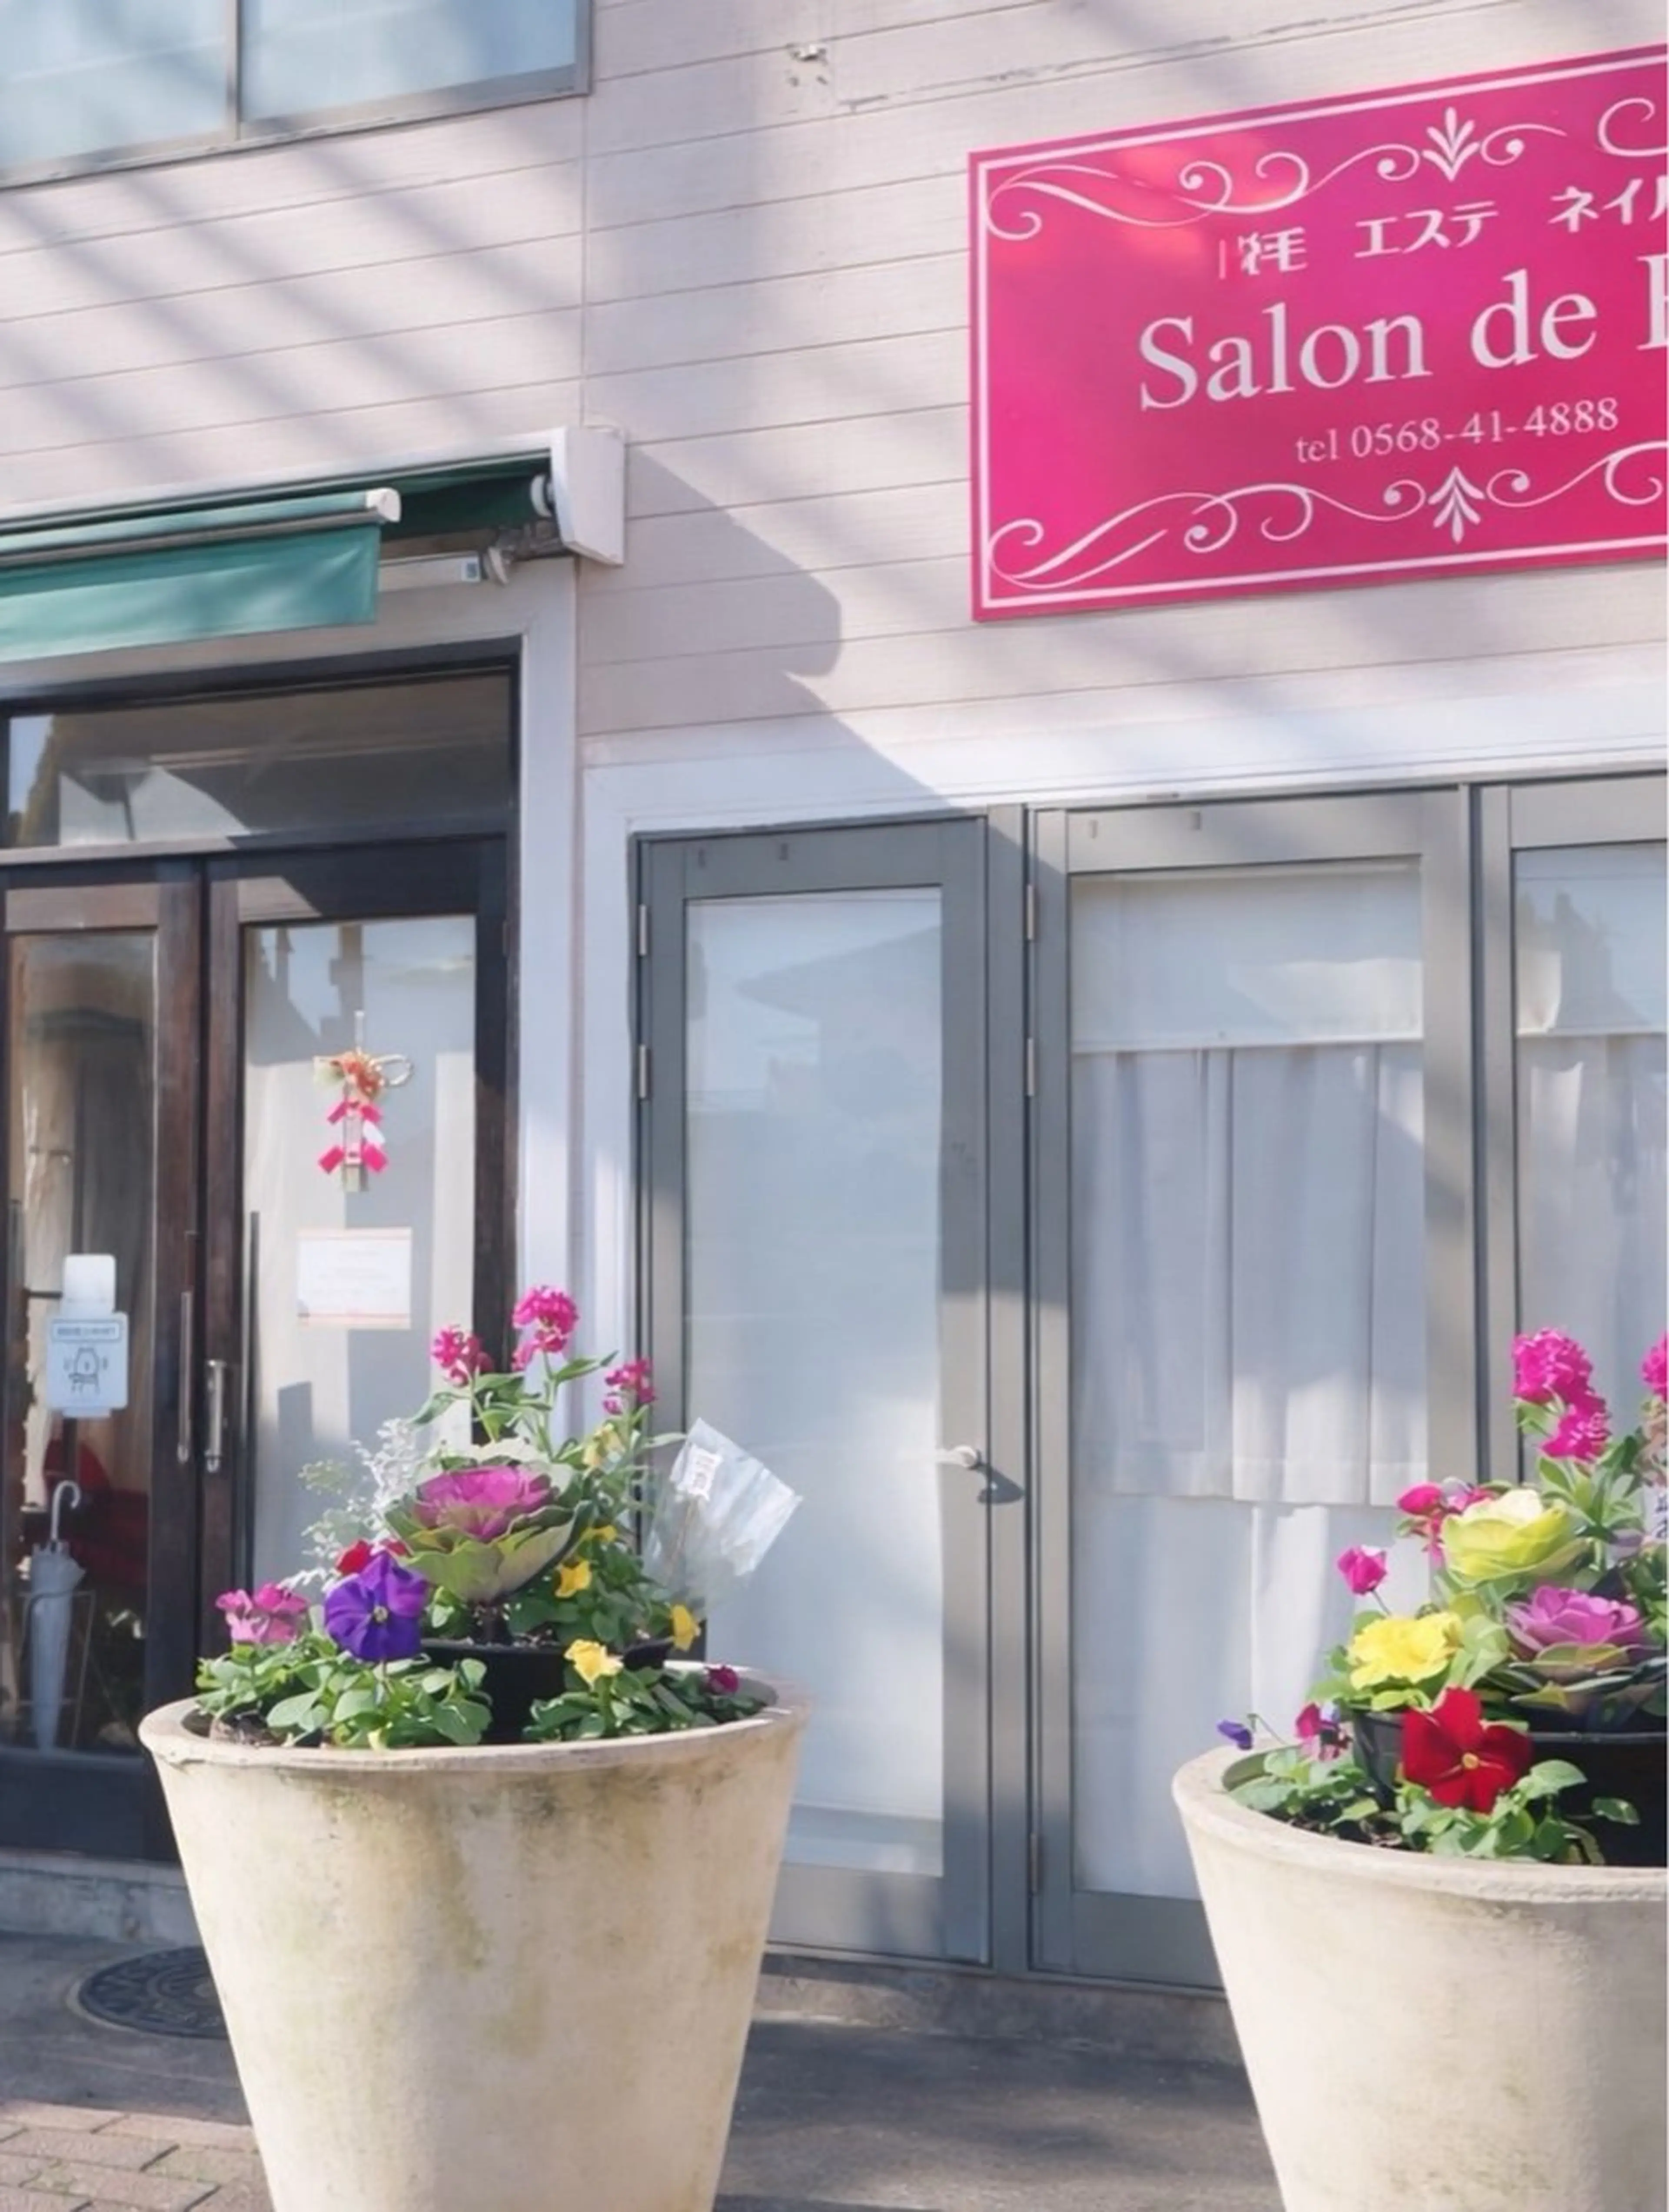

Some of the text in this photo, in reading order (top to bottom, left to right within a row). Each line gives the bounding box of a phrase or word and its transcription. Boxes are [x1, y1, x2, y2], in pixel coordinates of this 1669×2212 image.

[1354, 200, 1499, 258] エステ
[1138, 300, 1433, 411] Salon
[1469, 267, 1599, 369] de
[1295, 397, 1619, 463] tel 0568-41-4888
